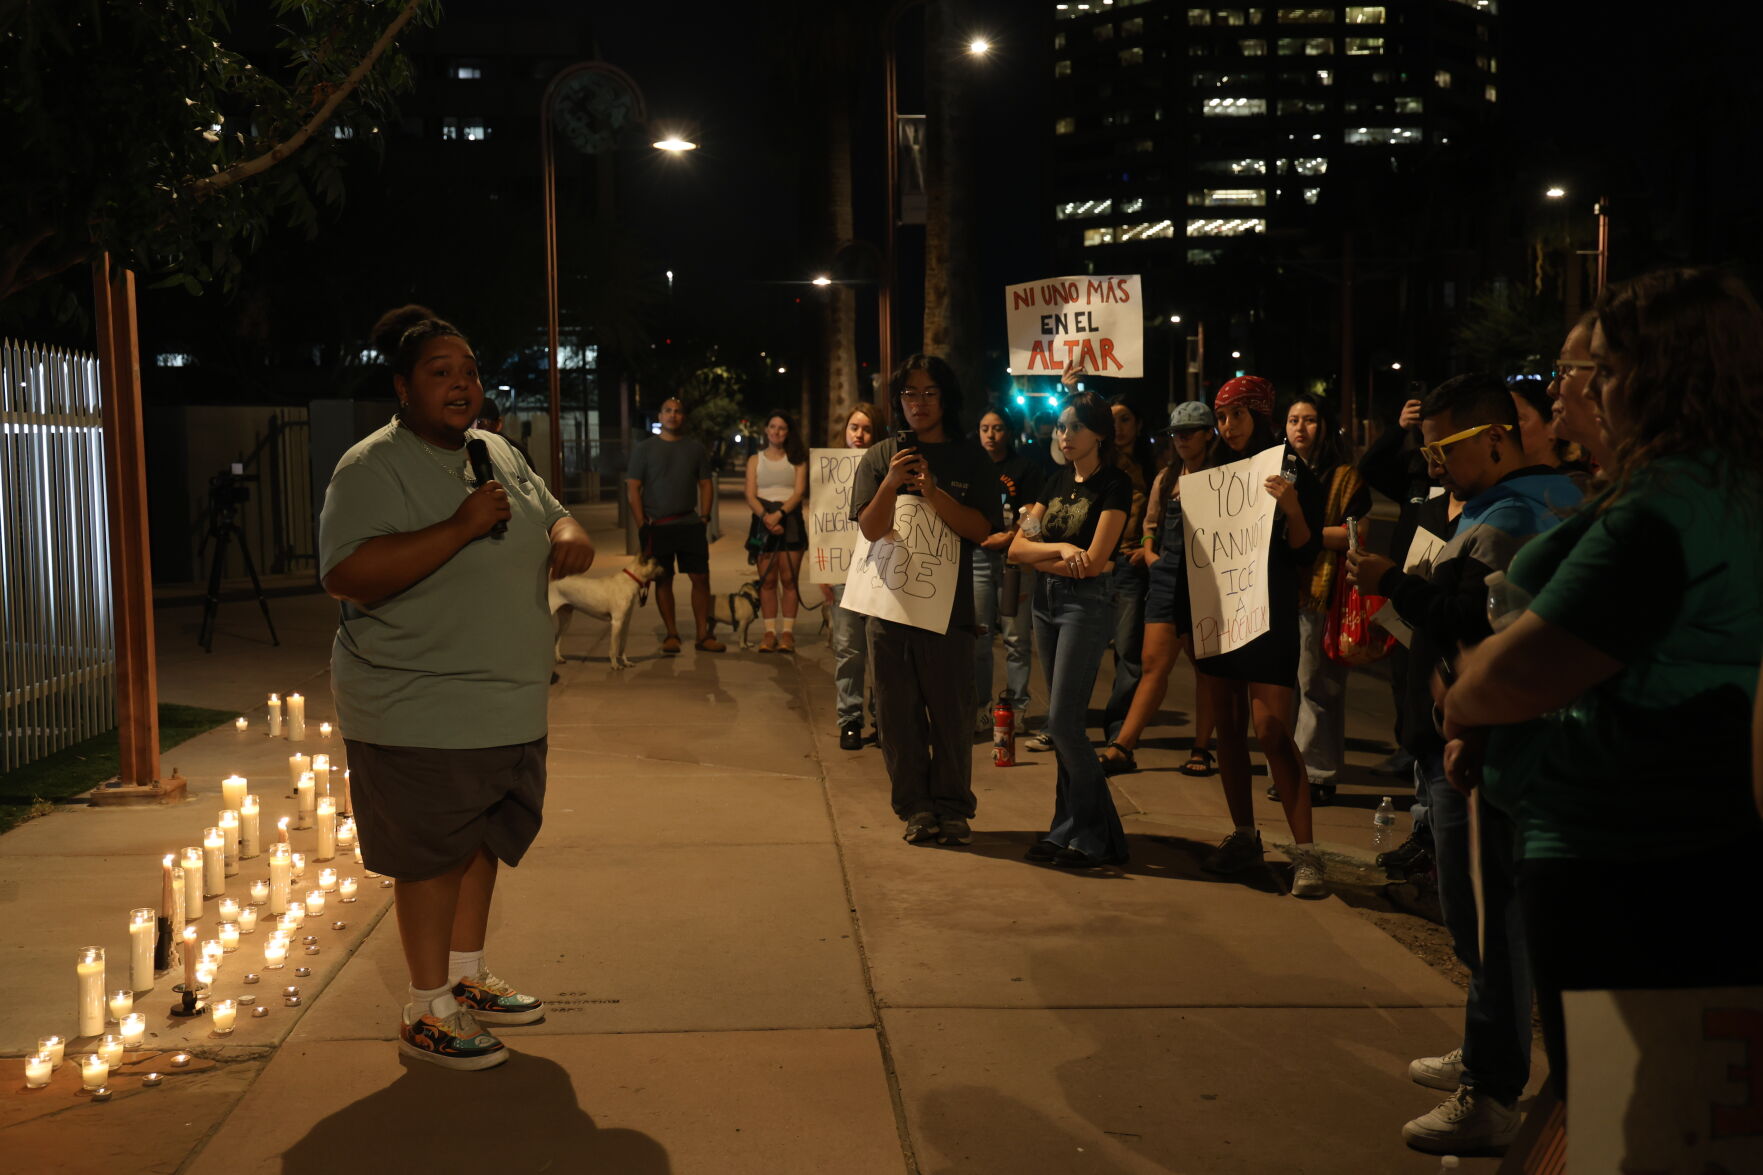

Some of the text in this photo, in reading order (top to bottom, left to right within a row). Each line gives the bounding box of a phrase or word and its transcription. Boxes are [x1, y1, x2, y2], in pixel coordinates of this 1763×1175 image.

[1013, 277, 1130, 311] NI UNO MÁS
[1040, 311, 1100, 335] EN EL
[1027, 338, 1124, 372] ALTAR
[1208, 471, 1260, 518] YOU
[1191, 514, 1266, 569] CANNOT
[1221, 560, 1255, 596] ICE
[1236, 597, 1248, 618] A
[1196, 605, 1268, 657] PHOENIX
